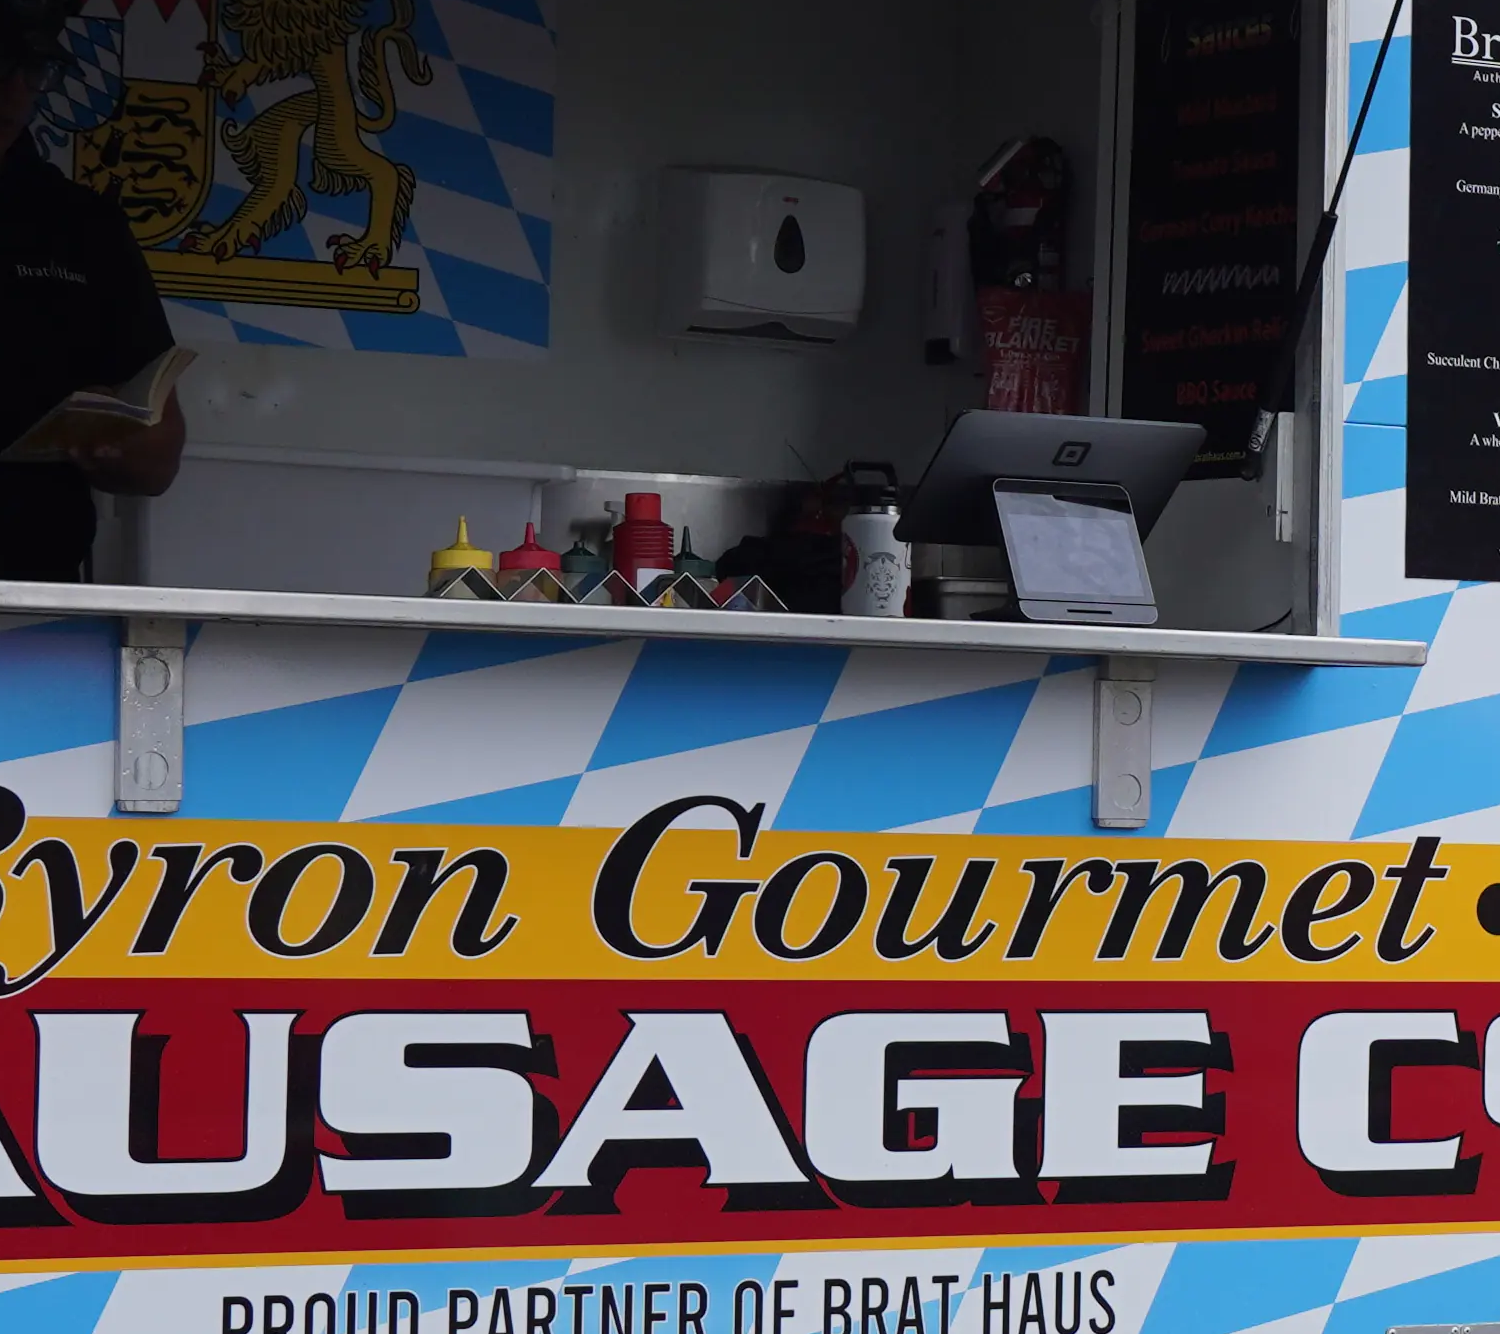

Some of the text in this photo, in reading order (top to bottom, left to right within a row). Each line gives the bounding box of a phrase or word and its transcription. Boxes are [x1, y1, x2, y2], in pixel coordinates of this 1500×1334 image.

[1185, 13, 1273, 58] Sauces
[1459, 122, 1469, 135] A
[1001, 314, 1058, 333] FIRE
[984, 327, 1081, 354] BLANKET
[1427, 352, 1481, 369] Succulent
[1211, 379, 1258, 403] Sauce
[1469, 433, 1480, 447] A
[1449, 490, 1476, 505] Mild
[588, 793, 1449, 969] Gourmet
